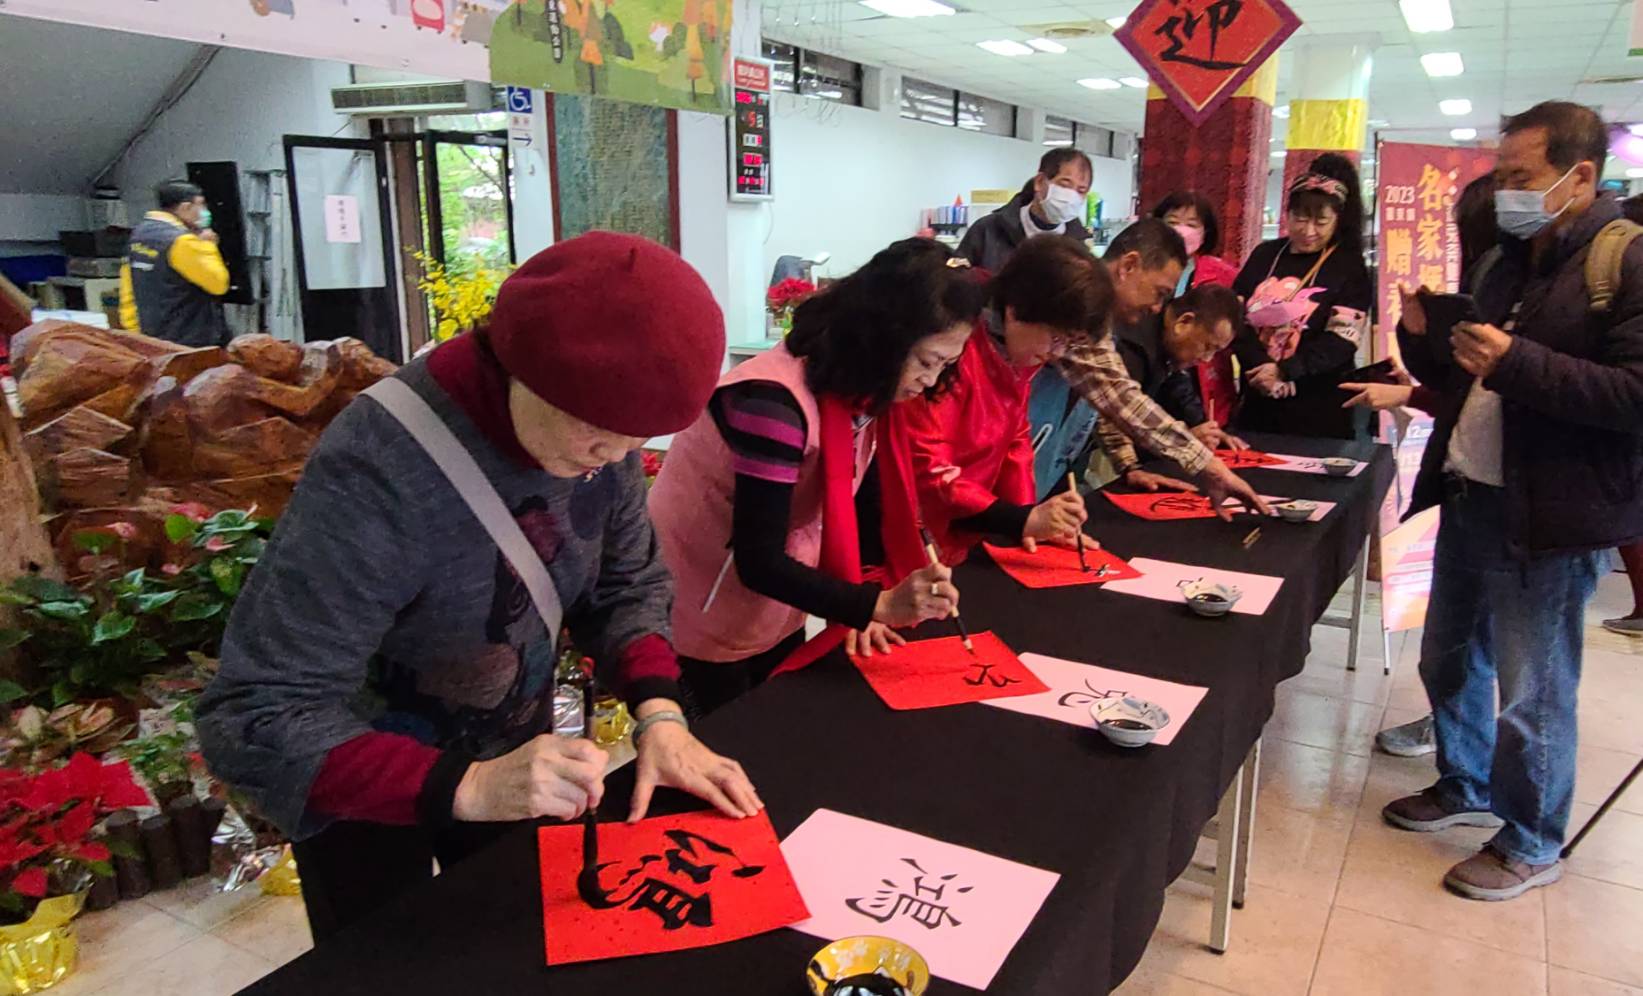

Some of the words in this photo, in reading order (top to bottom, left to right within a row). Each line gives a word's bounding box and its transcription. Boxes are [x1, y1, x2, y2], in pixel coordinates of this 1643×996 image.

[1154, 0, 1248, 70] 迎
[1385, 185, 1415, 204] 2023
[846, 858, 975, 930] 鴻
